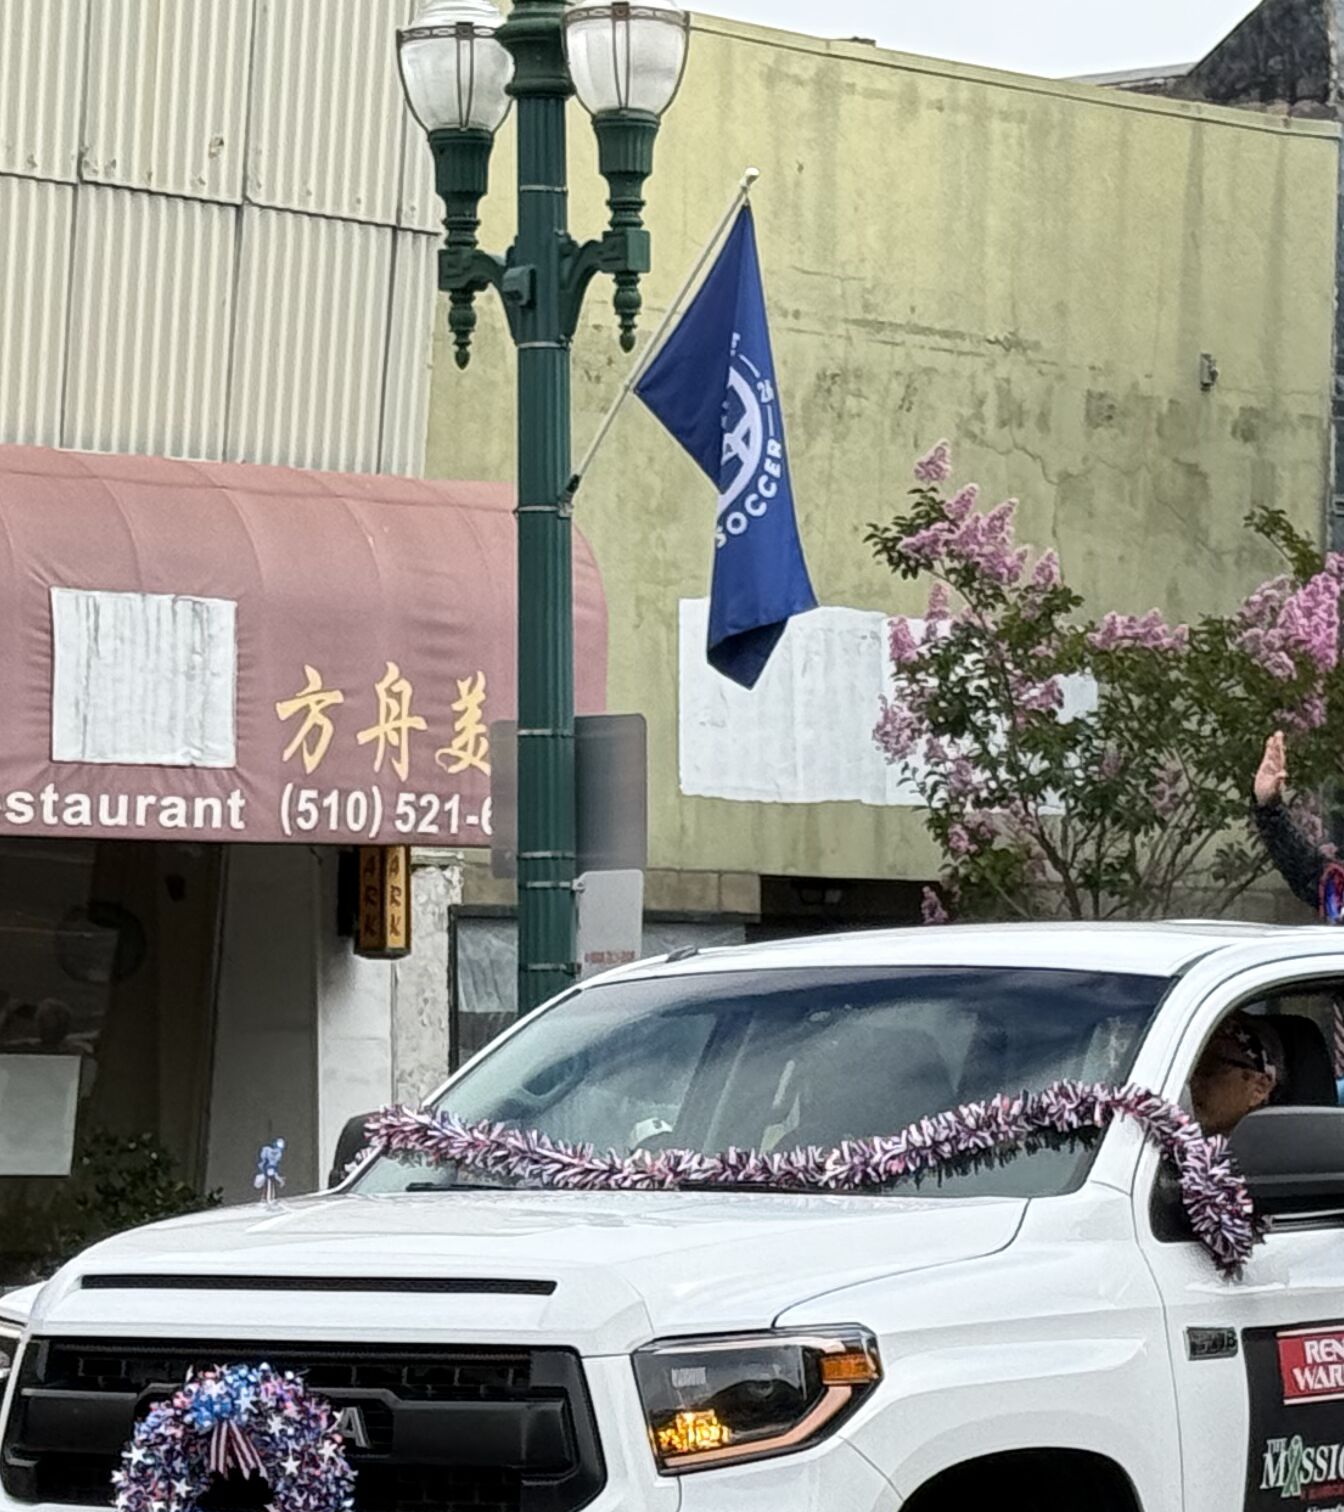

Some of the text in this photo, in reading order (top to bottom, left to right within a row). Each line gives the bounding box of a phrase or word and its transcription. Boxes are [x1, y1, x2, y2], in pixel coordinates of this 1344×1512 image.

[715, 438, 783, 549] SOCCER
[279, 782, 384, 840] (510)
[389, 855, 402, 937] ARK
